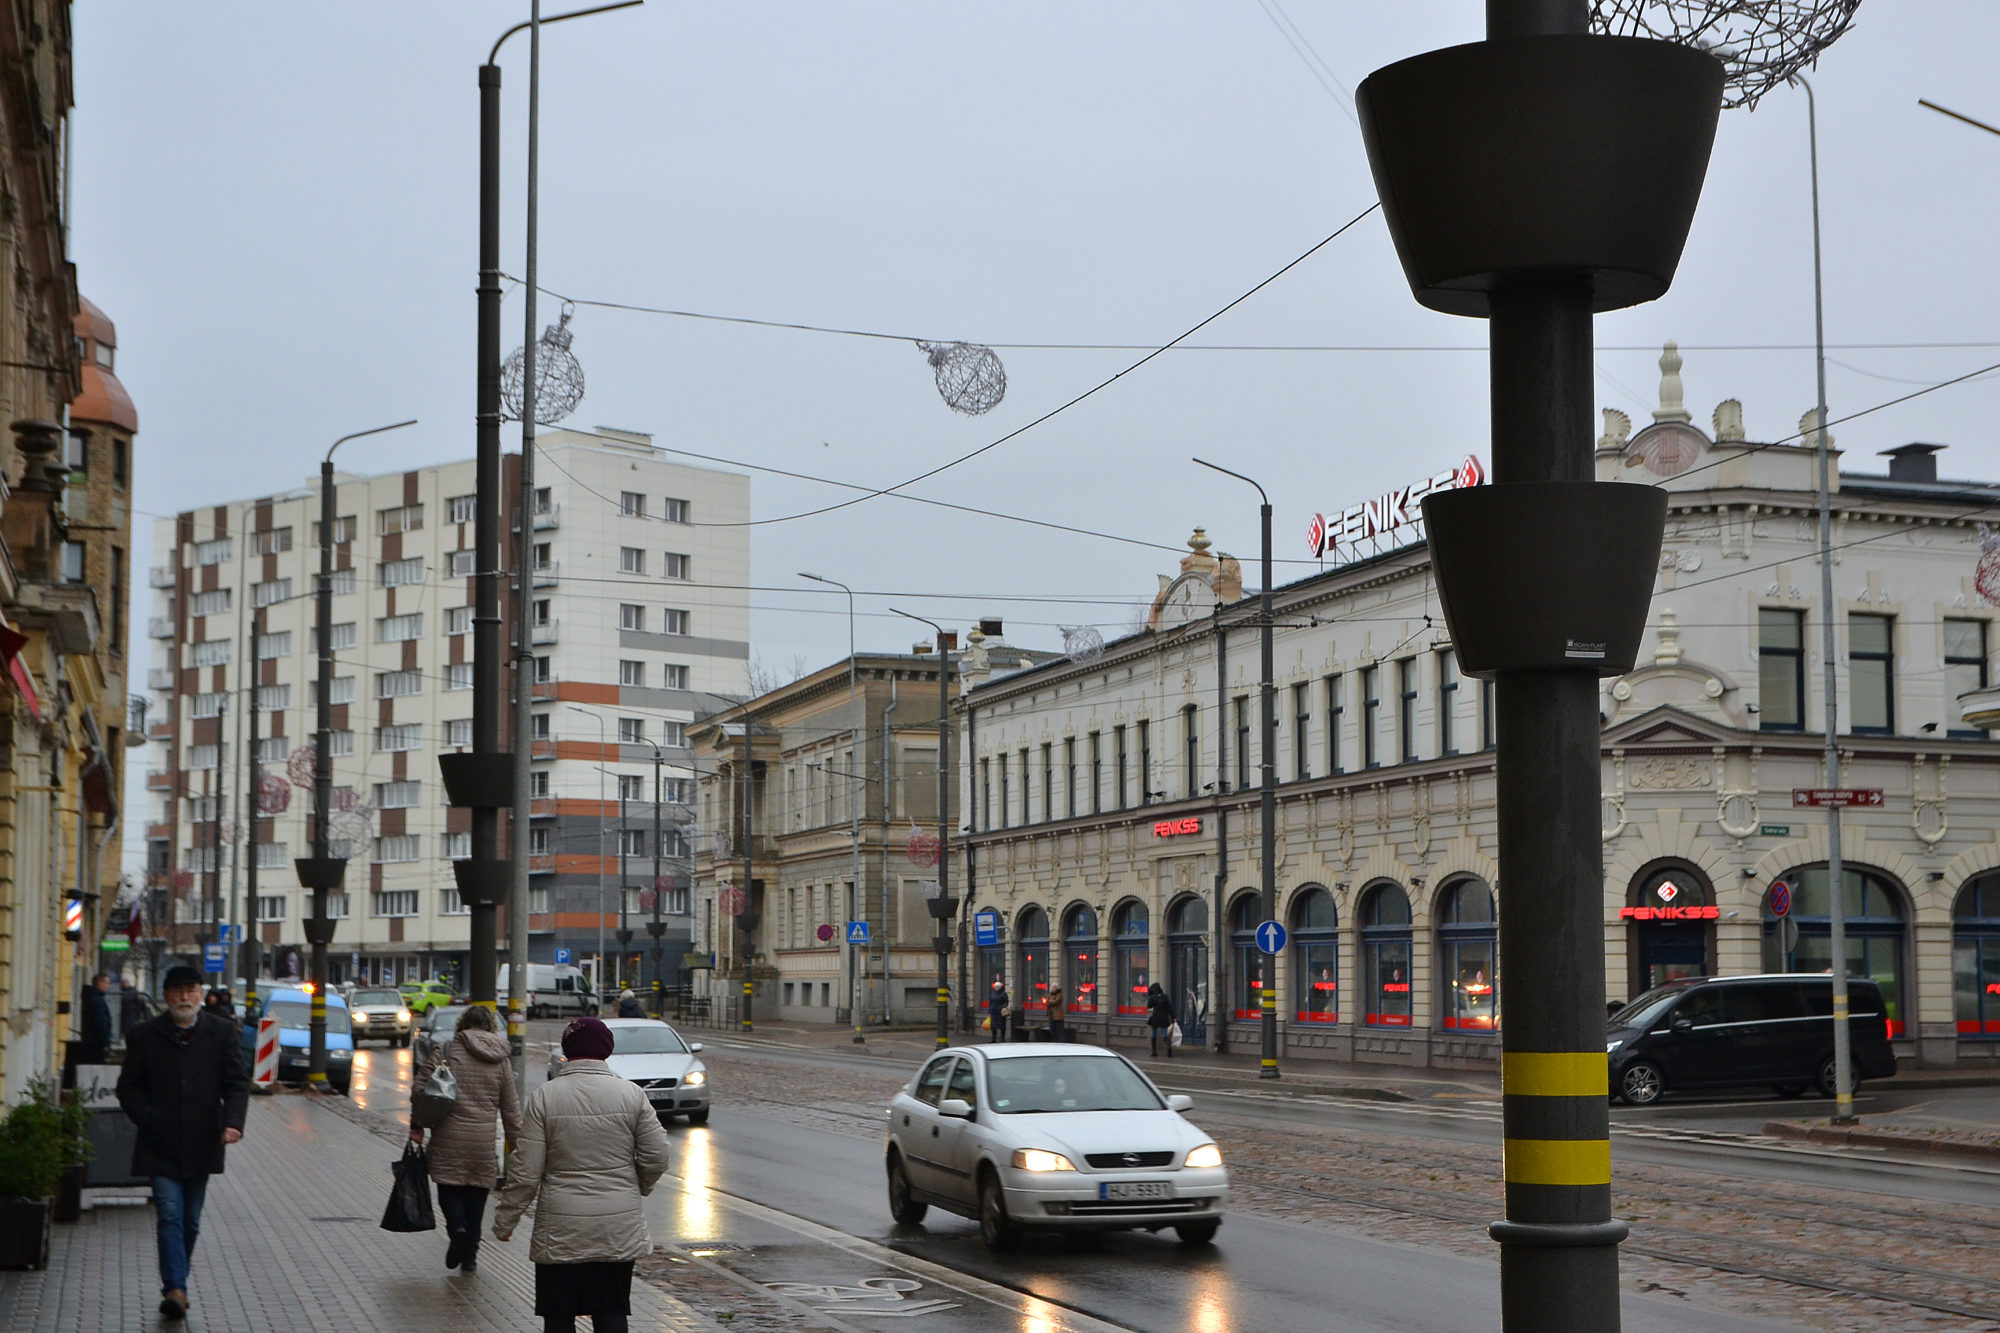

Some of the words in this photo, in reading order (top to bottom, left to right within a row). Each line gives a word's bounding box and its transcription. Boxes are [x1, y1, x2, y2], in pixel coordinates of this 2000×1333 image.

[1154, 817, 1199, 837] FENIKSS
[1619, 905, 1720, 920] FENIKSS
[557, 950, 568, 962] P
